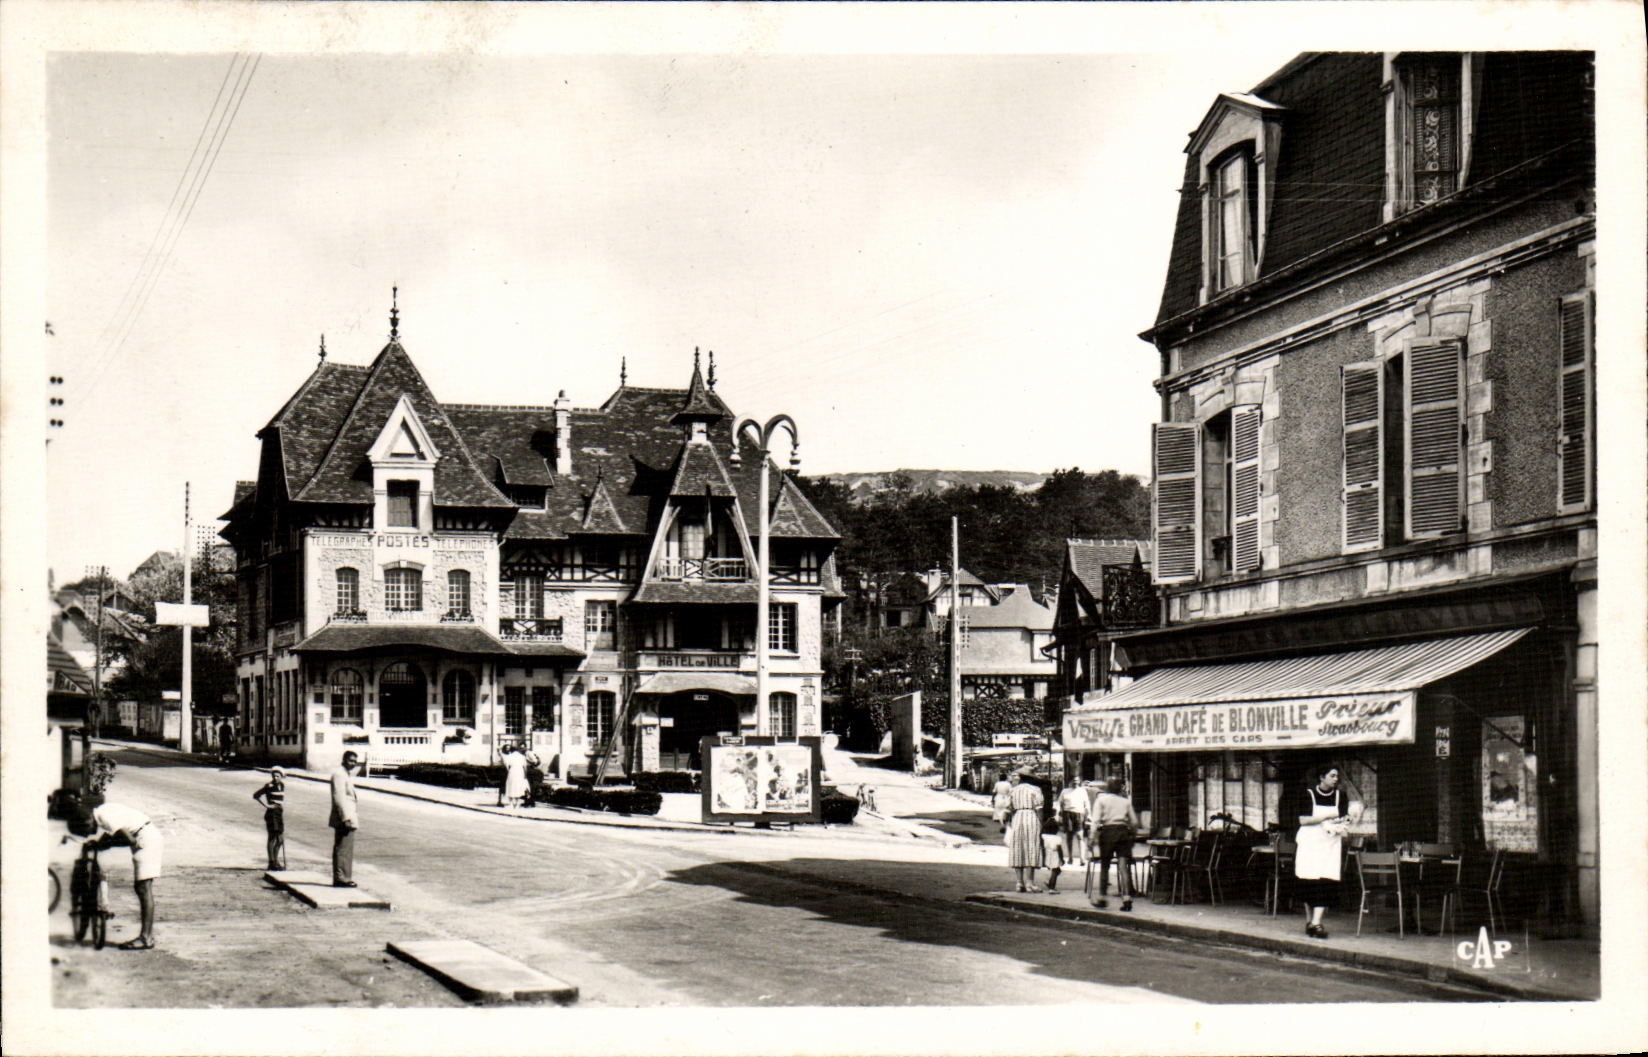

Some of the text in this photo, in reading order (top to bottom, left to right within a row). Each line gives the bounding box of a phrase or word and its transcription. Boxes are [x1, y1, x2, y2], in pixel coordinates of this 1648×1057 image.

[377, 535, 430, 548] POSTES
[1315, 699, 1401, 720] Prieur
[1129, 704, 1309, 737] GRAND CAFÉ DE BLONVILLE
[1318, 720, 1400, 737] Strasbourg
[1205, 735, 1226, 745] DES
[1232, 734, 1263, 744] CARS
